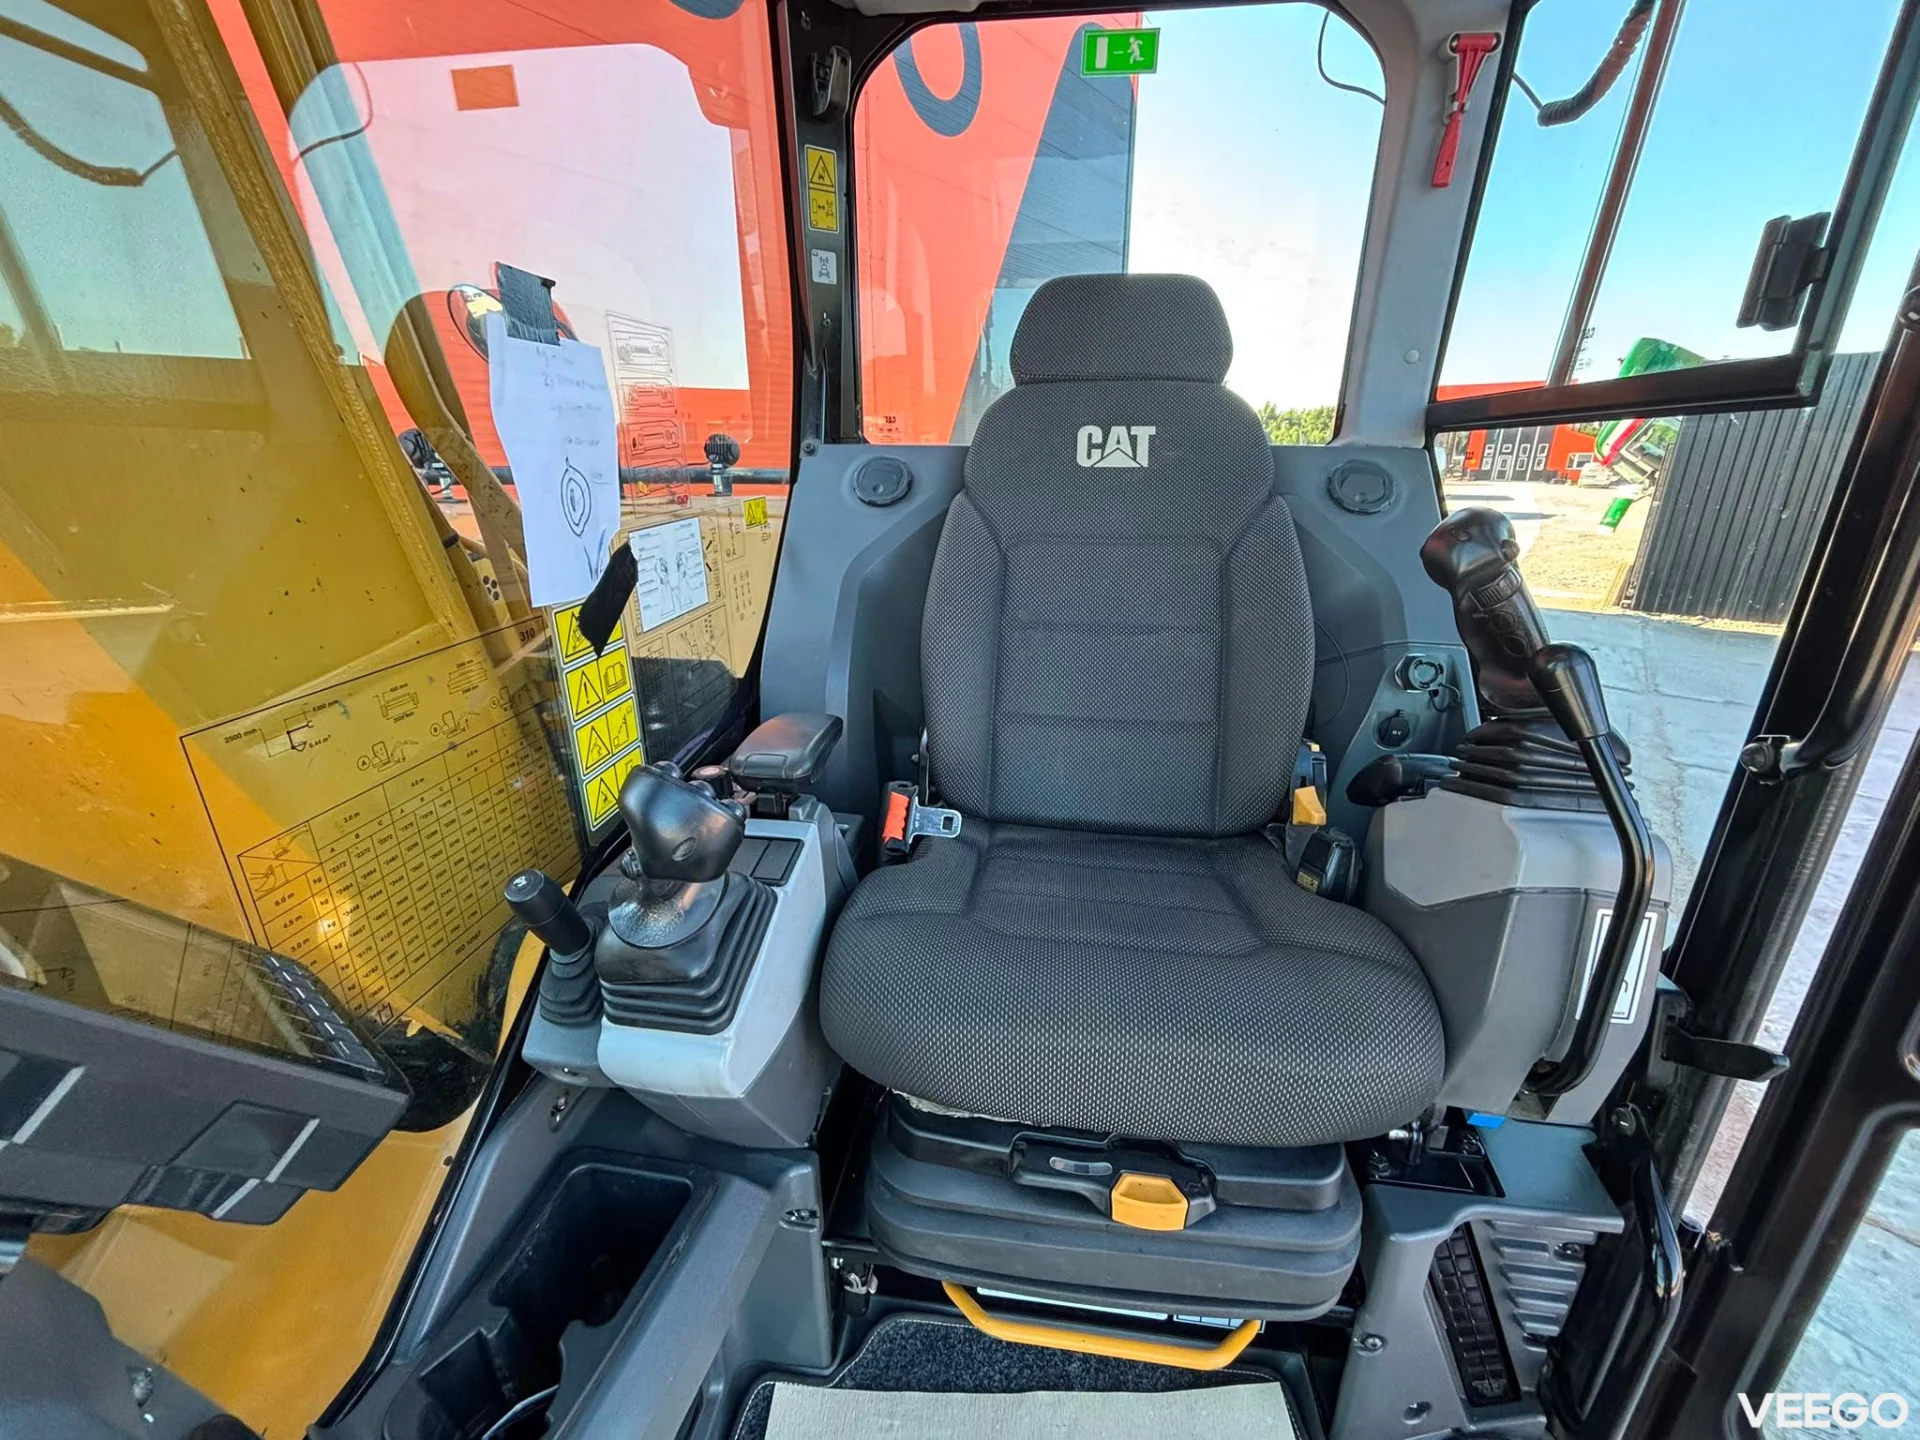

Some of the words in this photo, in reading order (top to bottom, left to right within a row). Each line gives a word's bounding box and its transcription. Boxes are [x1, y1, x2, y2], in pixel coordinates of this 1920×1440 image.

[1076, 425, 1156, 468] CAT
[519, 628, 535, 642] 310
[224, 733, 242, 744] 2500
[243, 728, 258, 737] mm
[376, 819, 383, 827] C
[286, 892, 295, 900] m
[294, 914, 303, 922] m
[302, 937, 310, 945] m
